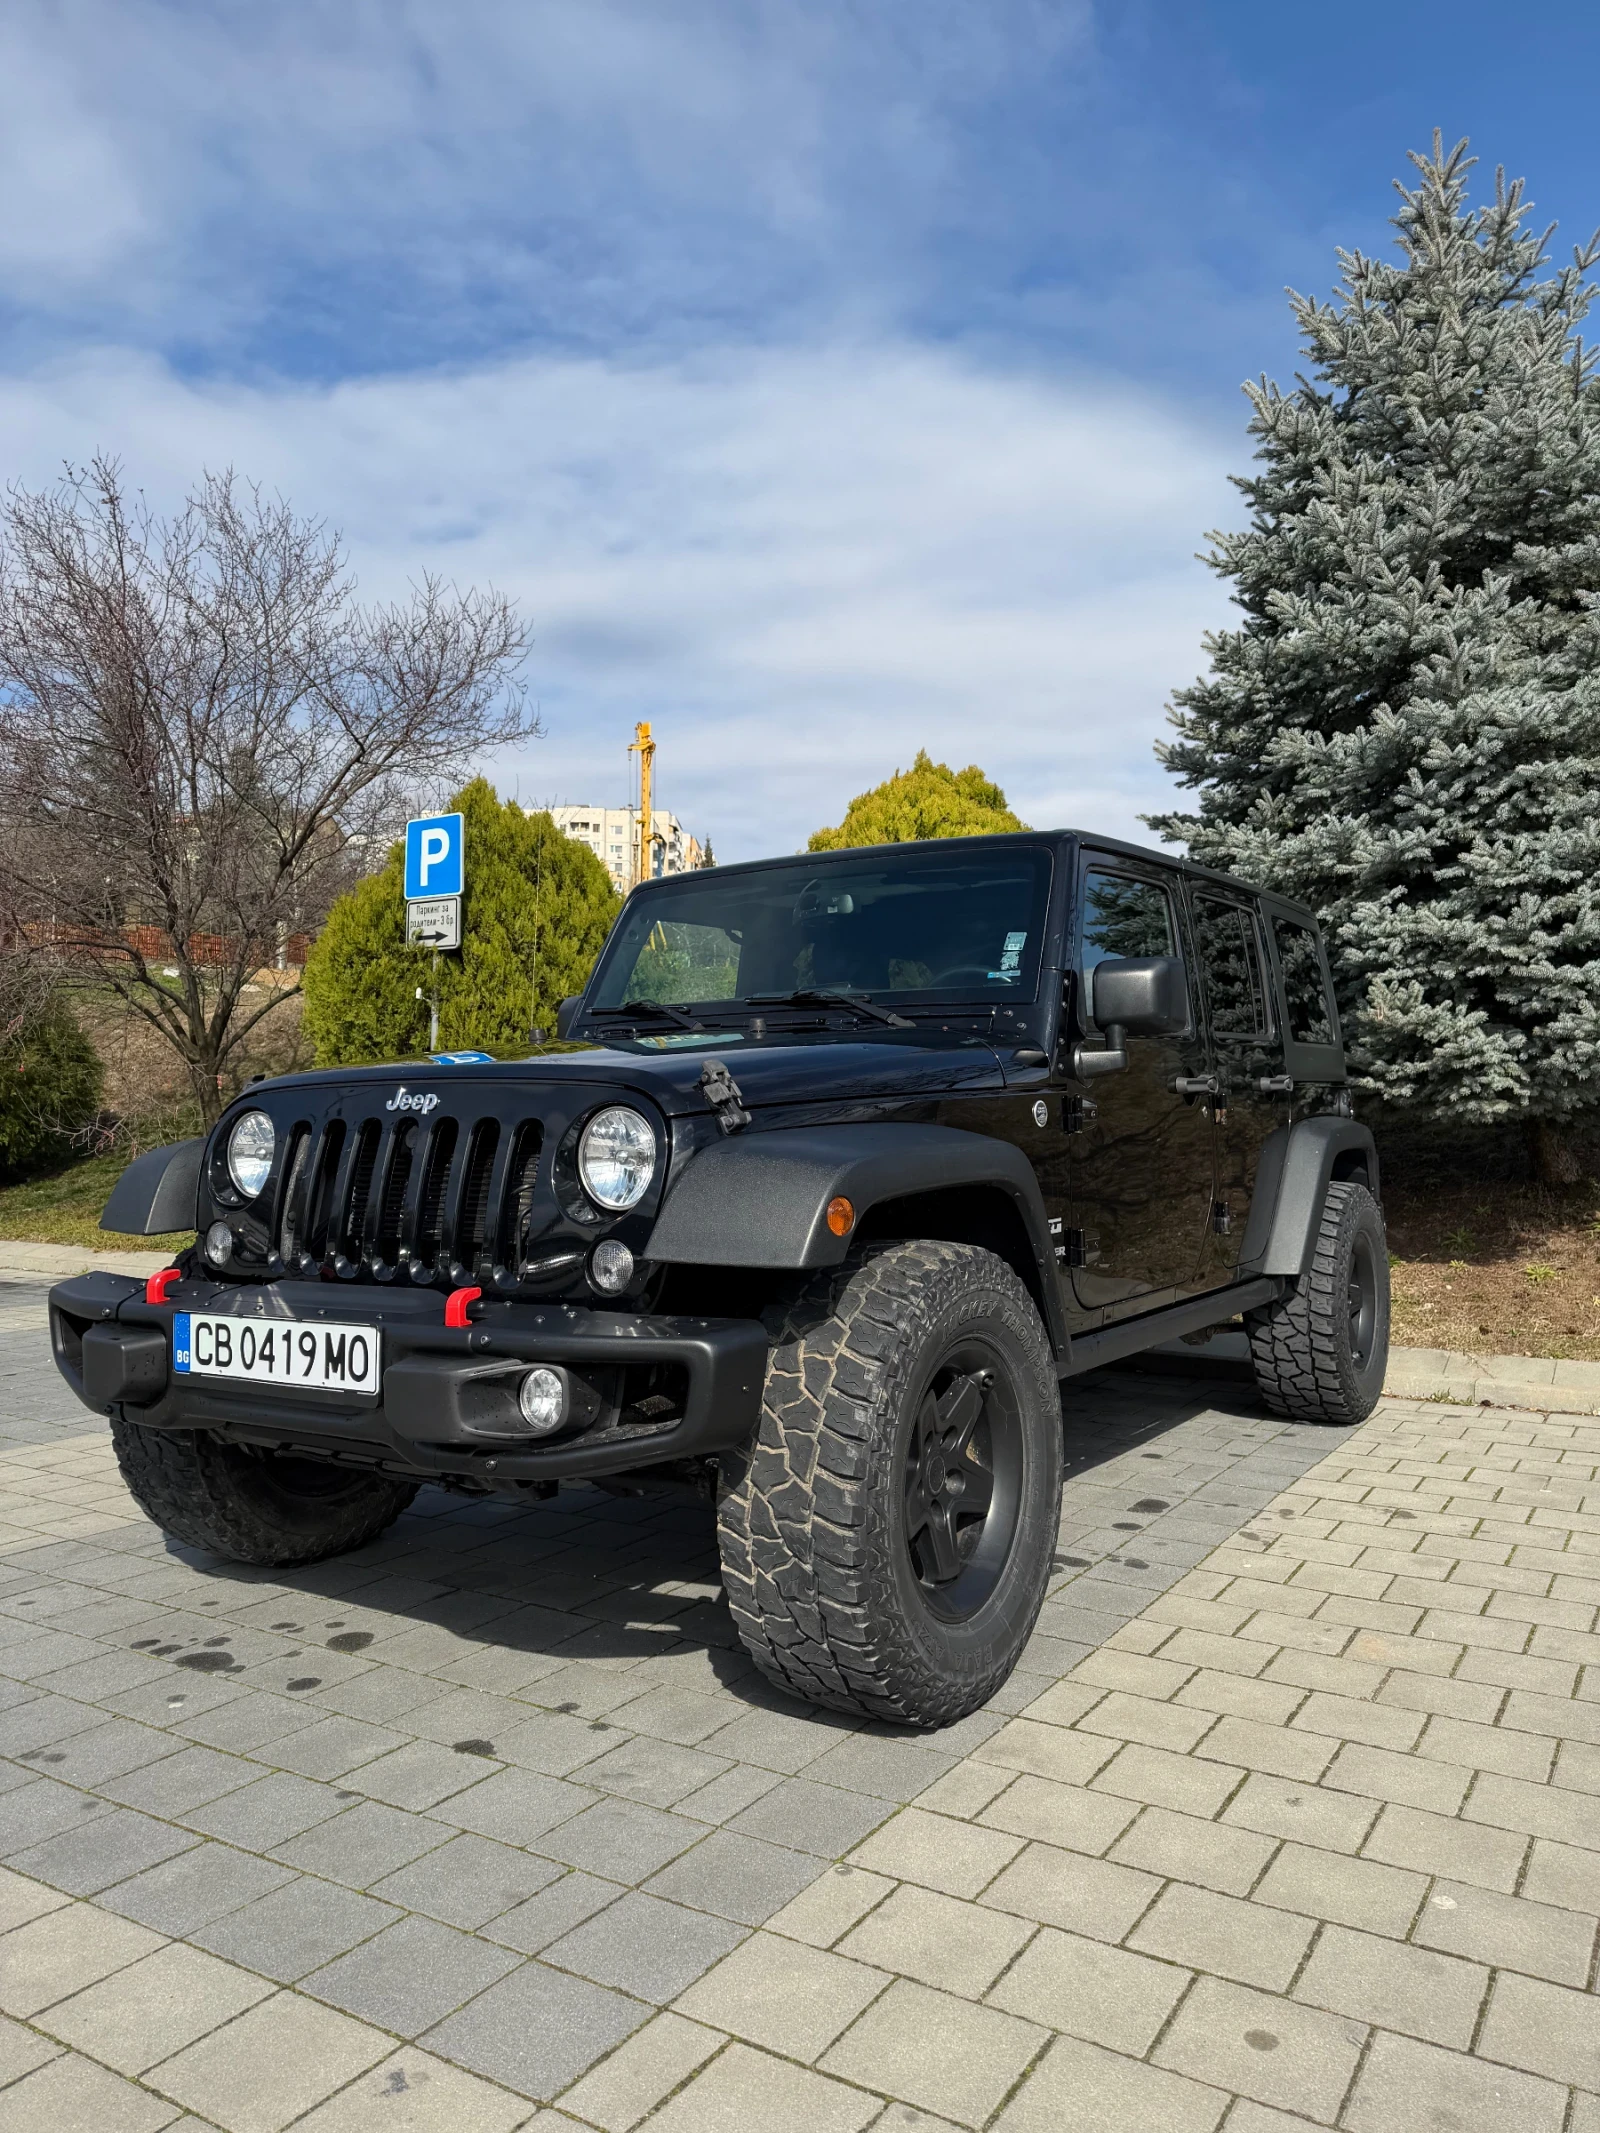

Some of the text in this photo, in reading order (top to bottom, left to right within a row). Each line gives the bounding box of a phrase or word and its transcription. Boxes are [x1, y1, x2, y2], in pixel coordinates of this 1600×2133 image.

[420, 828, 450, 887] P
[416, 904, 449, 917] Паркинг за
[386, 1085, 439, 1115] Jeep
[176, 1349, 190, 1364] BG
[195, 1321, 369, 1383] CB 0419 MO
[1000, 1306, 1052, 1418] THOMPSON
